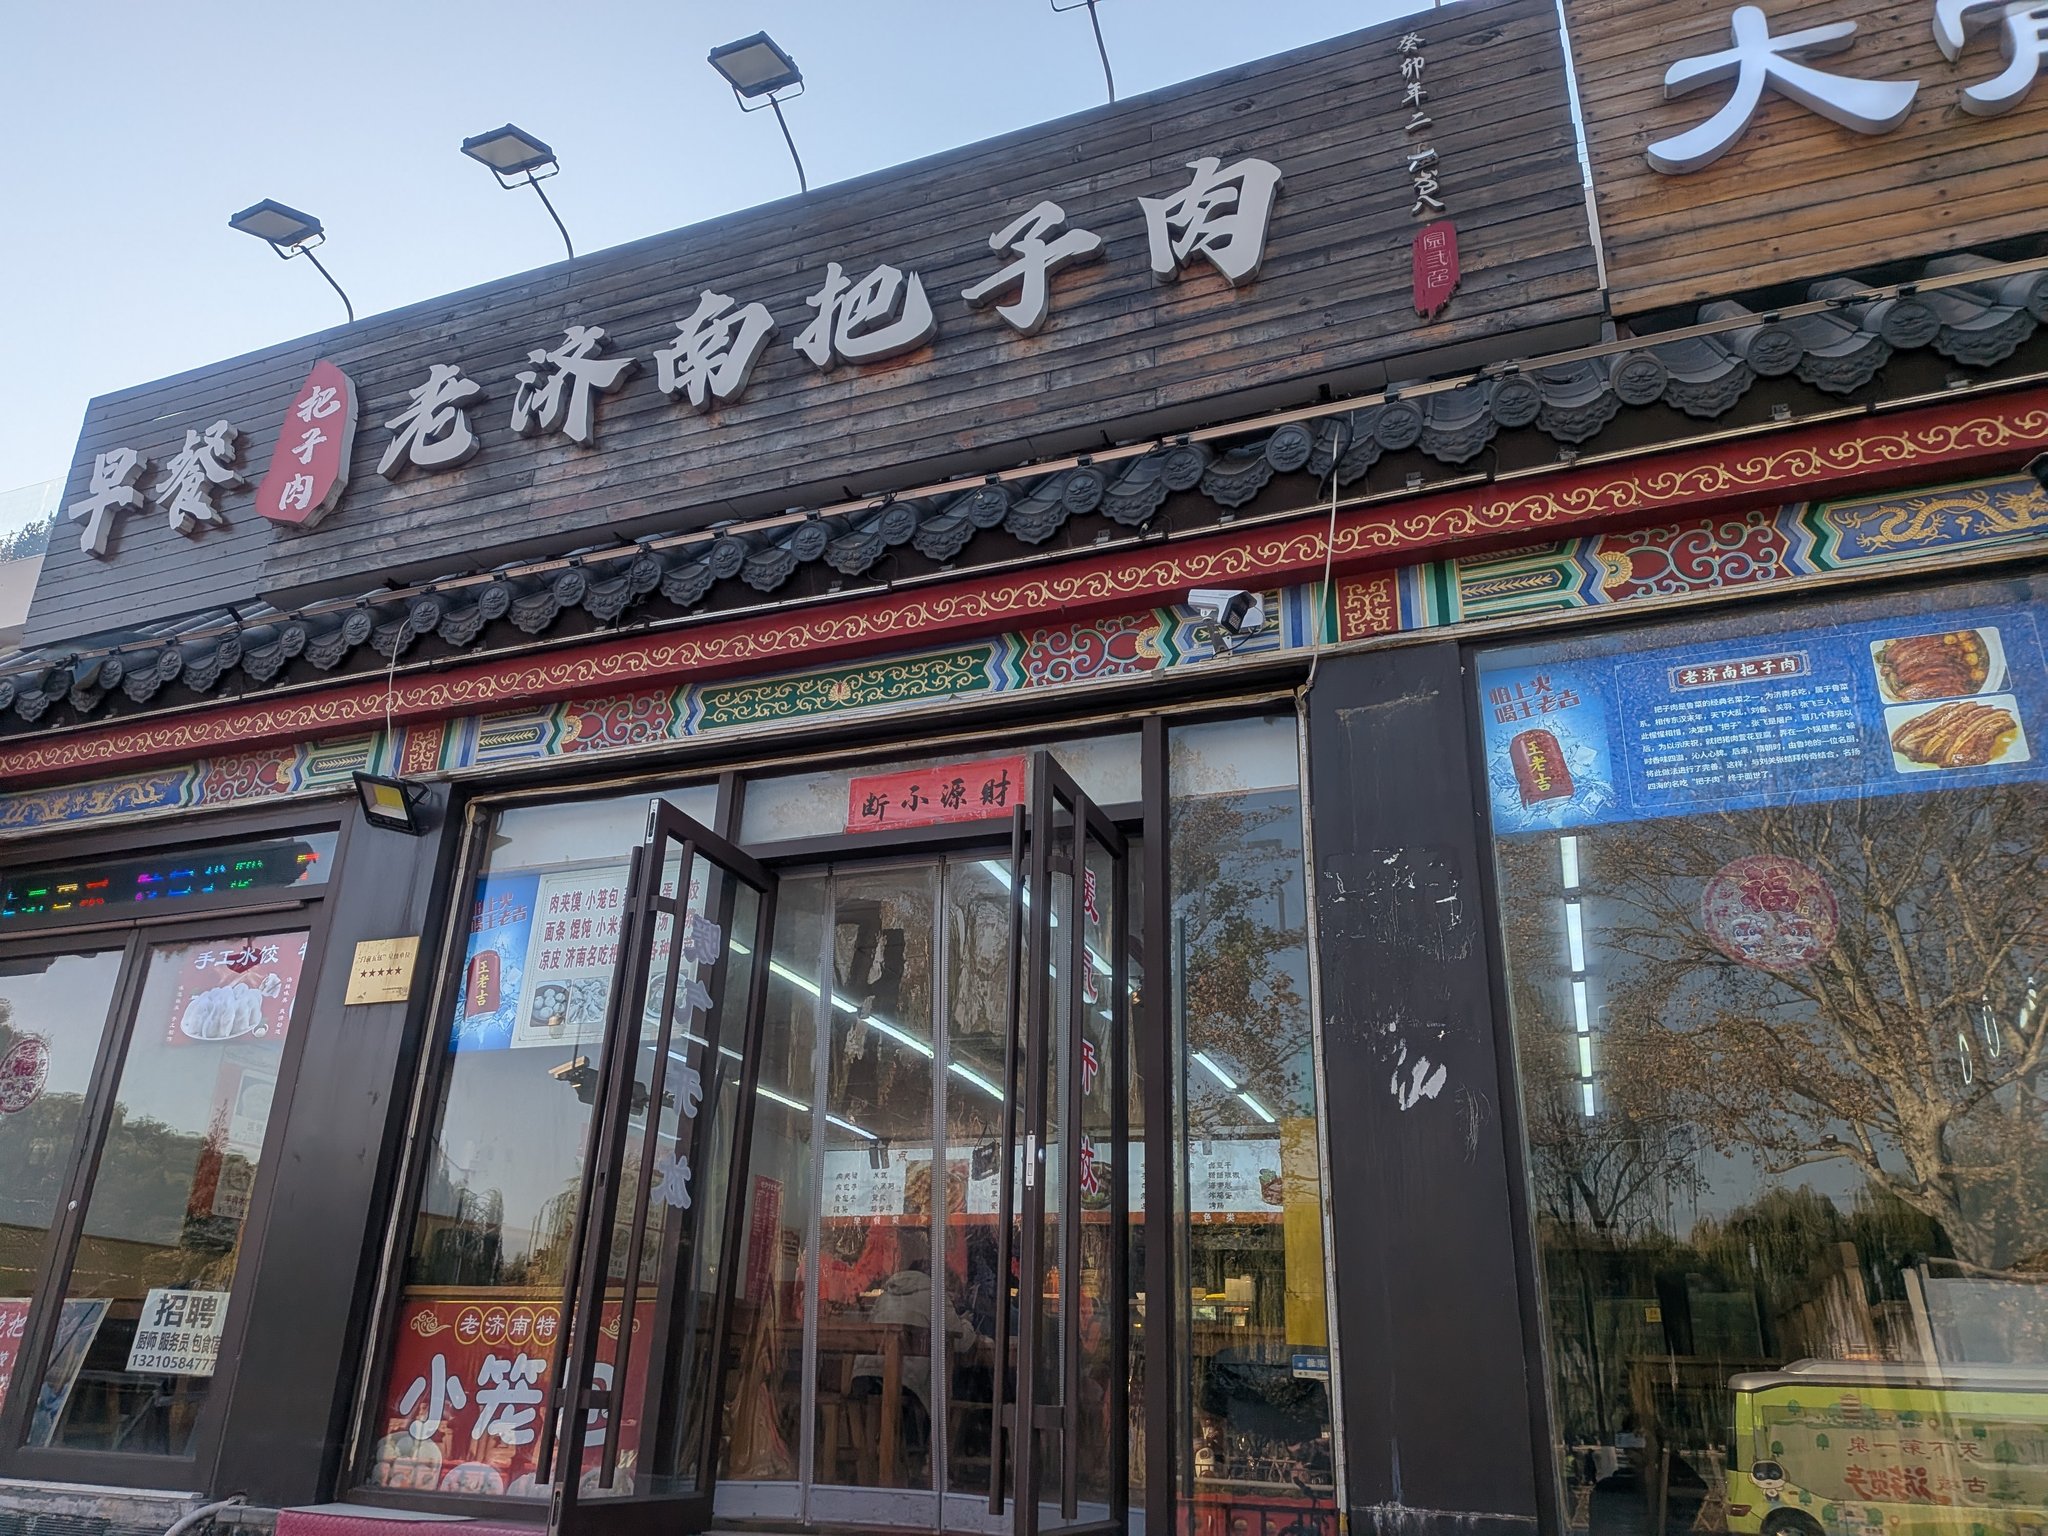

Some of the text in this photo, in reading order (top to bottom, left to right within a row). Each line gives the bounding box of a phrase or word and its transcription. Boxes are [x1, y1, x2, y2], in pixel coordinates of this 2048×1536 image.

[376, 156, 1284, 480] 老济南把子肉
[279, 384, 341, 511] 把子肉
[67, 418, 247, 556] 早餐
[1682, 657, 1796, 684] 老济南把子肉
[1489, 675, 1554, 705] 怕上火
[1495, 690, 1581, 725] 喝王老吉
[1527, 741, 1551, 792] 王老吉
[549, 891, 582, 914] 肉夹馍
[585, 887, 619, 911] 小笼包
[544, 920, 566, 942] 面条
[569, 918, 592, 940] 馄饨
[596, 914, 624, 937] 小米
[194, 944, 280, 969] 手工水饺
[539, 949, 562, 971] 凉皮
[475, 960, 490, 1006] 王老吉
[154, 1293, 219, 1329] 招聘
[459, 1314, 577, 1337] 老济南特
[136, 1331, 159, 1350] 厨师
[159, 1332, 191, 1353] 服务员
